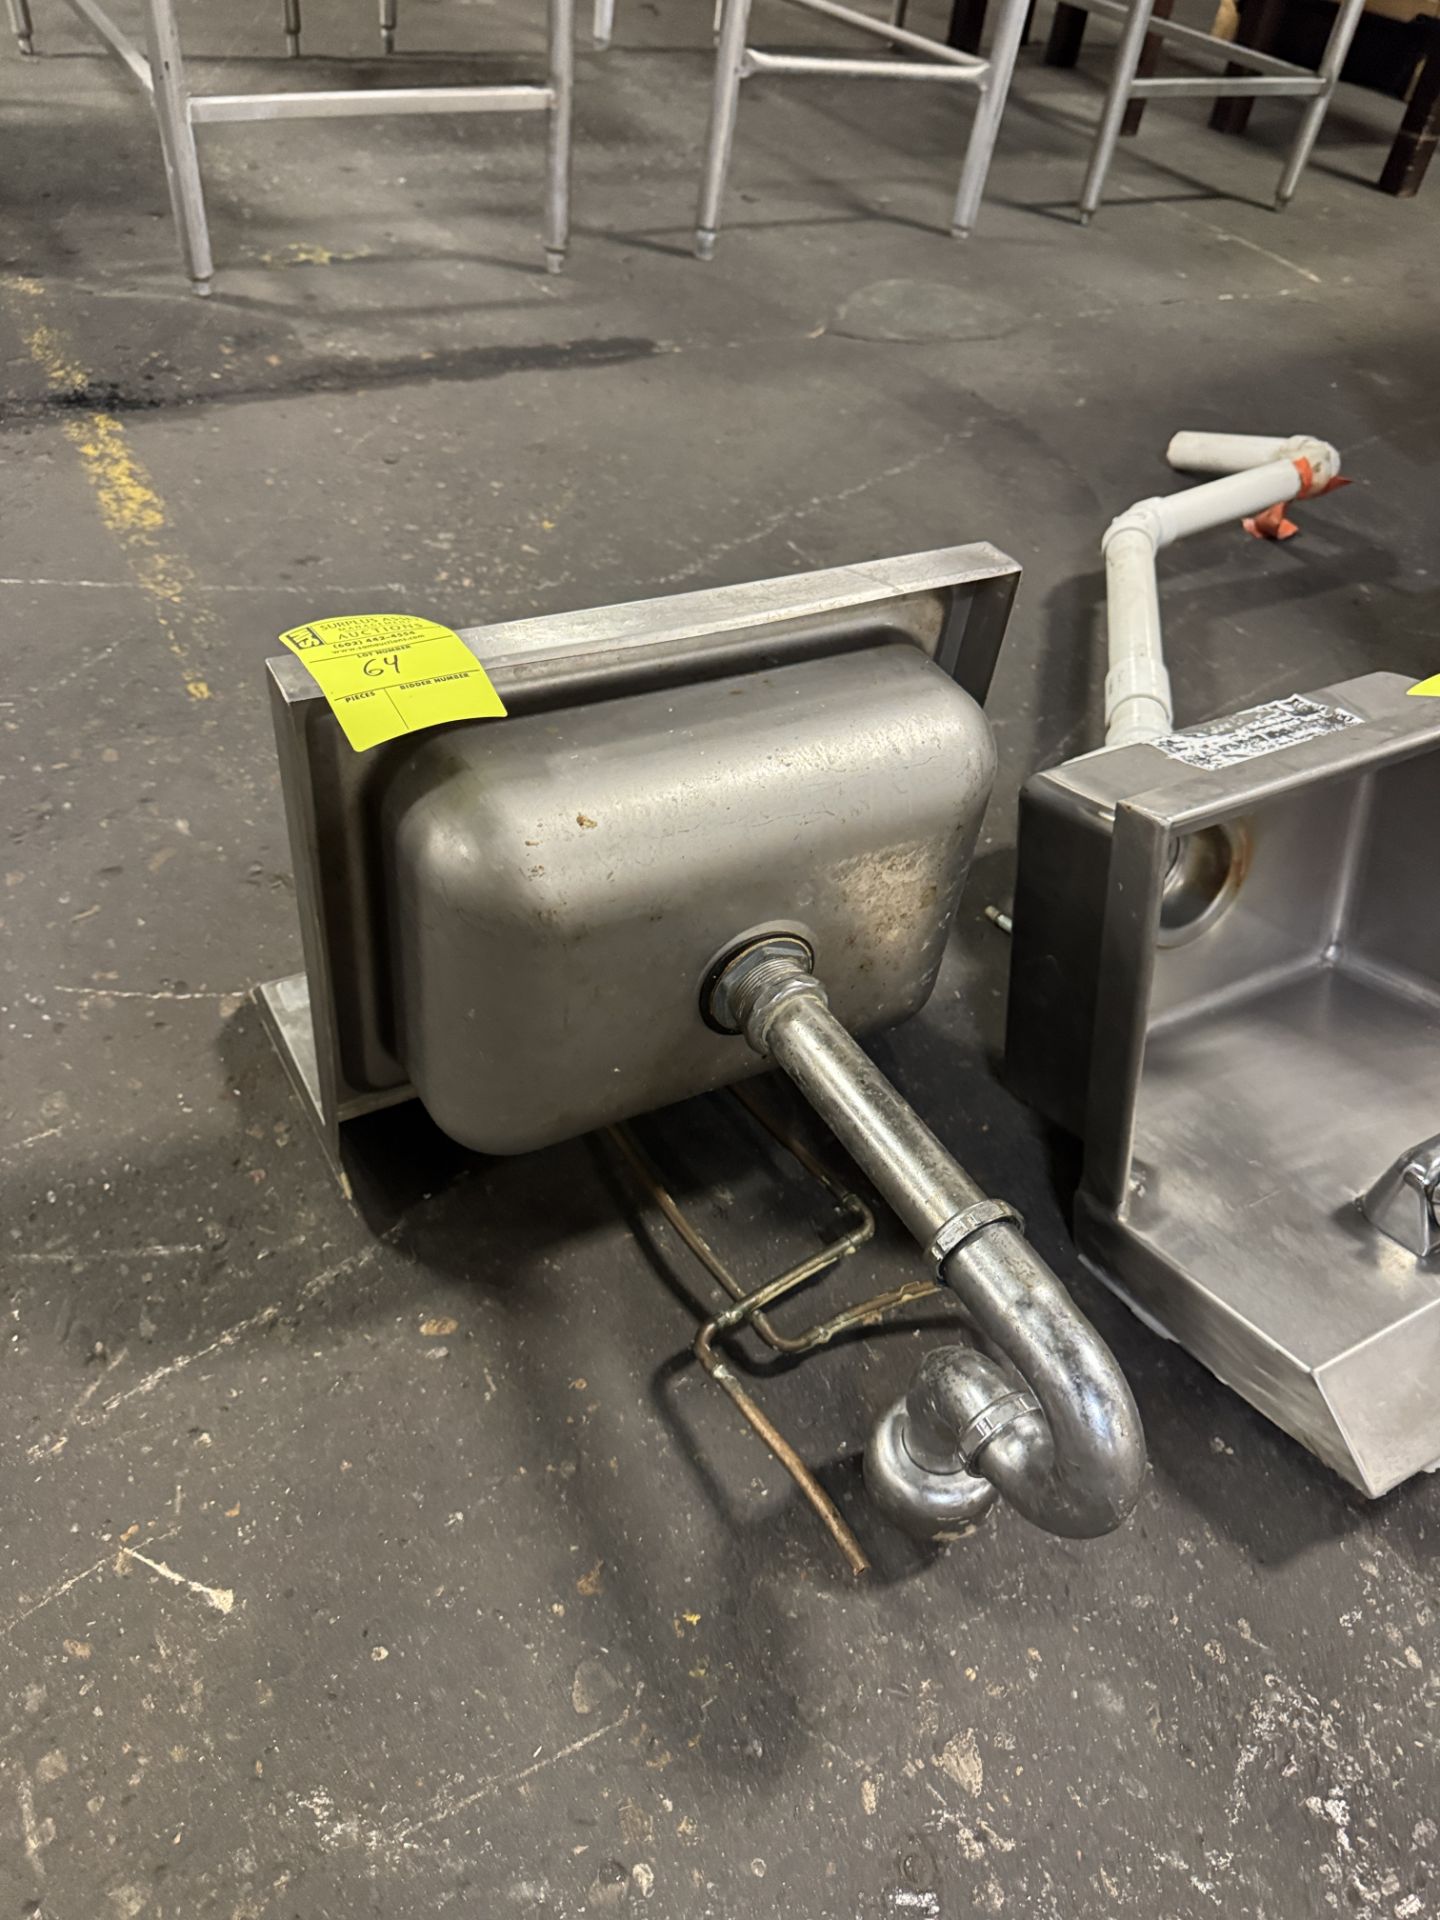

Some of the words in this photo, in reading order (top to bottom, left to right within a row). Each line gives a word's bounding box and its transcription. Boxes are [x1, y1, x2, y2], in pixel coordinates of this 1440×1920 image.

[320, 617, 378, 630] SURPLUS
[338, 623, 423, 640] AUCTIONS
[375, 645, 411, 655] NUMBER
[363, 655, 400, 677] 64
[400, 680, 432, 690] BIDDER
[434, 672, 469, 684] NUMBER
[345, 691, 376, 703] PIECES
